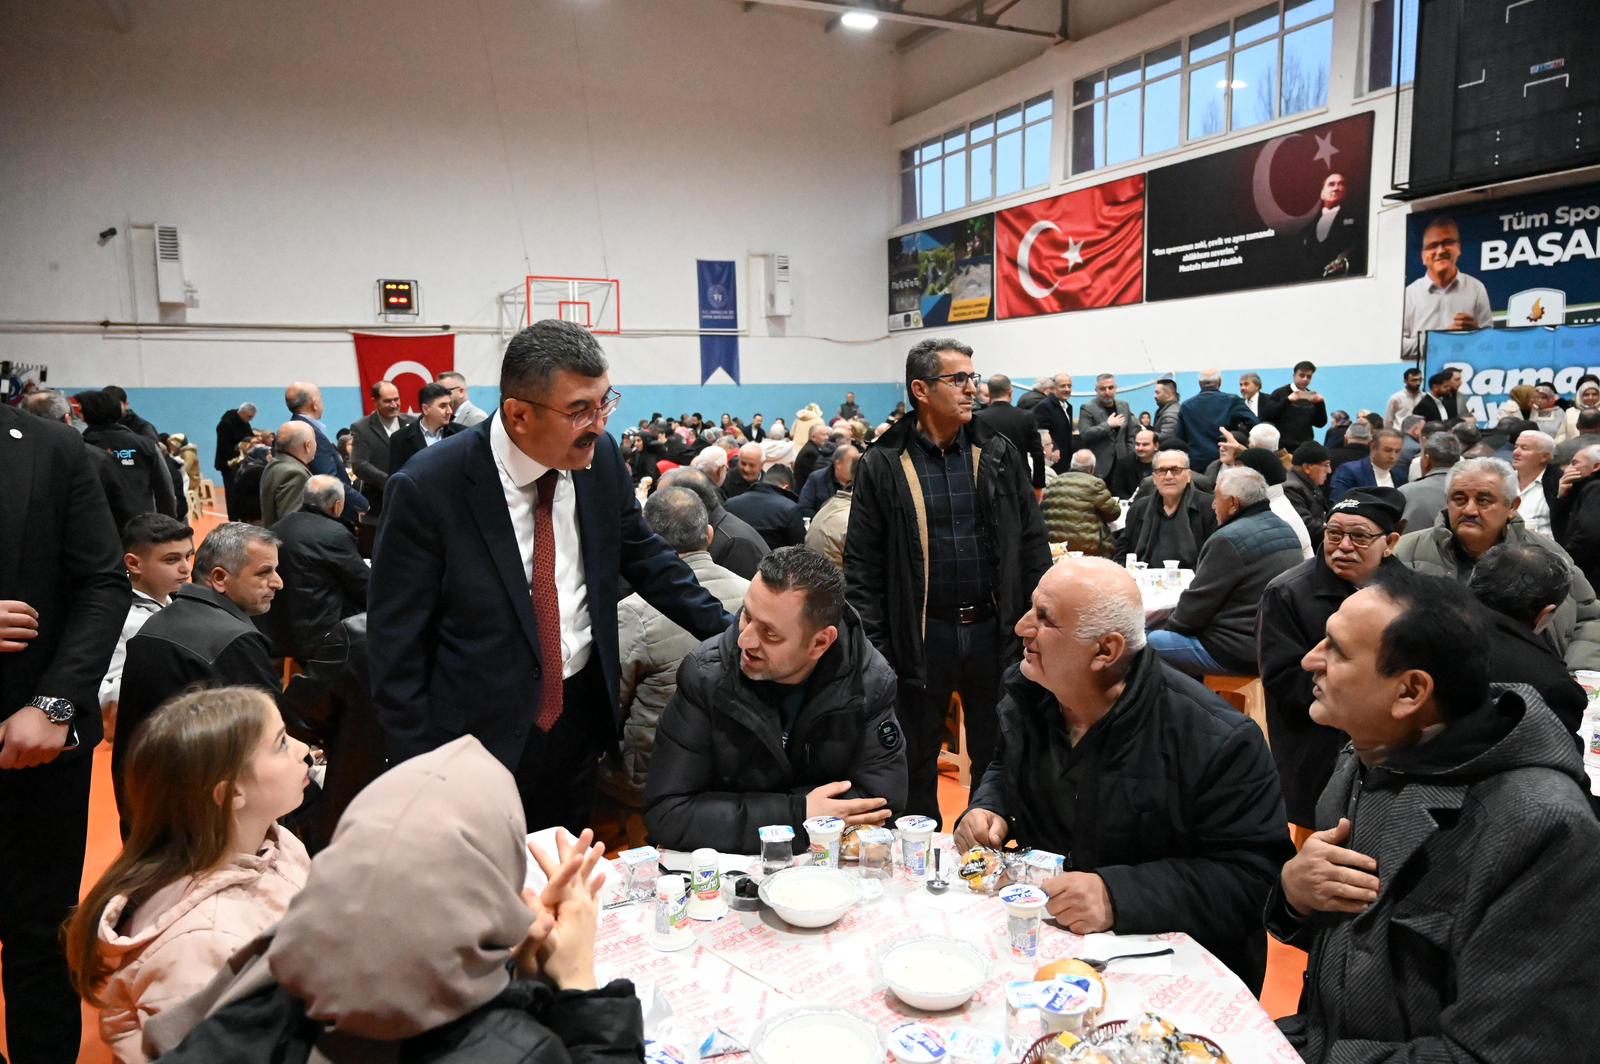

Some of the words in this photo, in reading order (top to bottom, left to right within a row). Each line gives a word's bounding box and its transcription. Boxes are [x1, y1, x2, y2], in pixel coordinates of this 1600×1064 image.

[1499, 211, 1548, 232] Tüm
[1480, 226, 1600, 271] BAŞA
[1444, 362, 1600, 396] Rama
